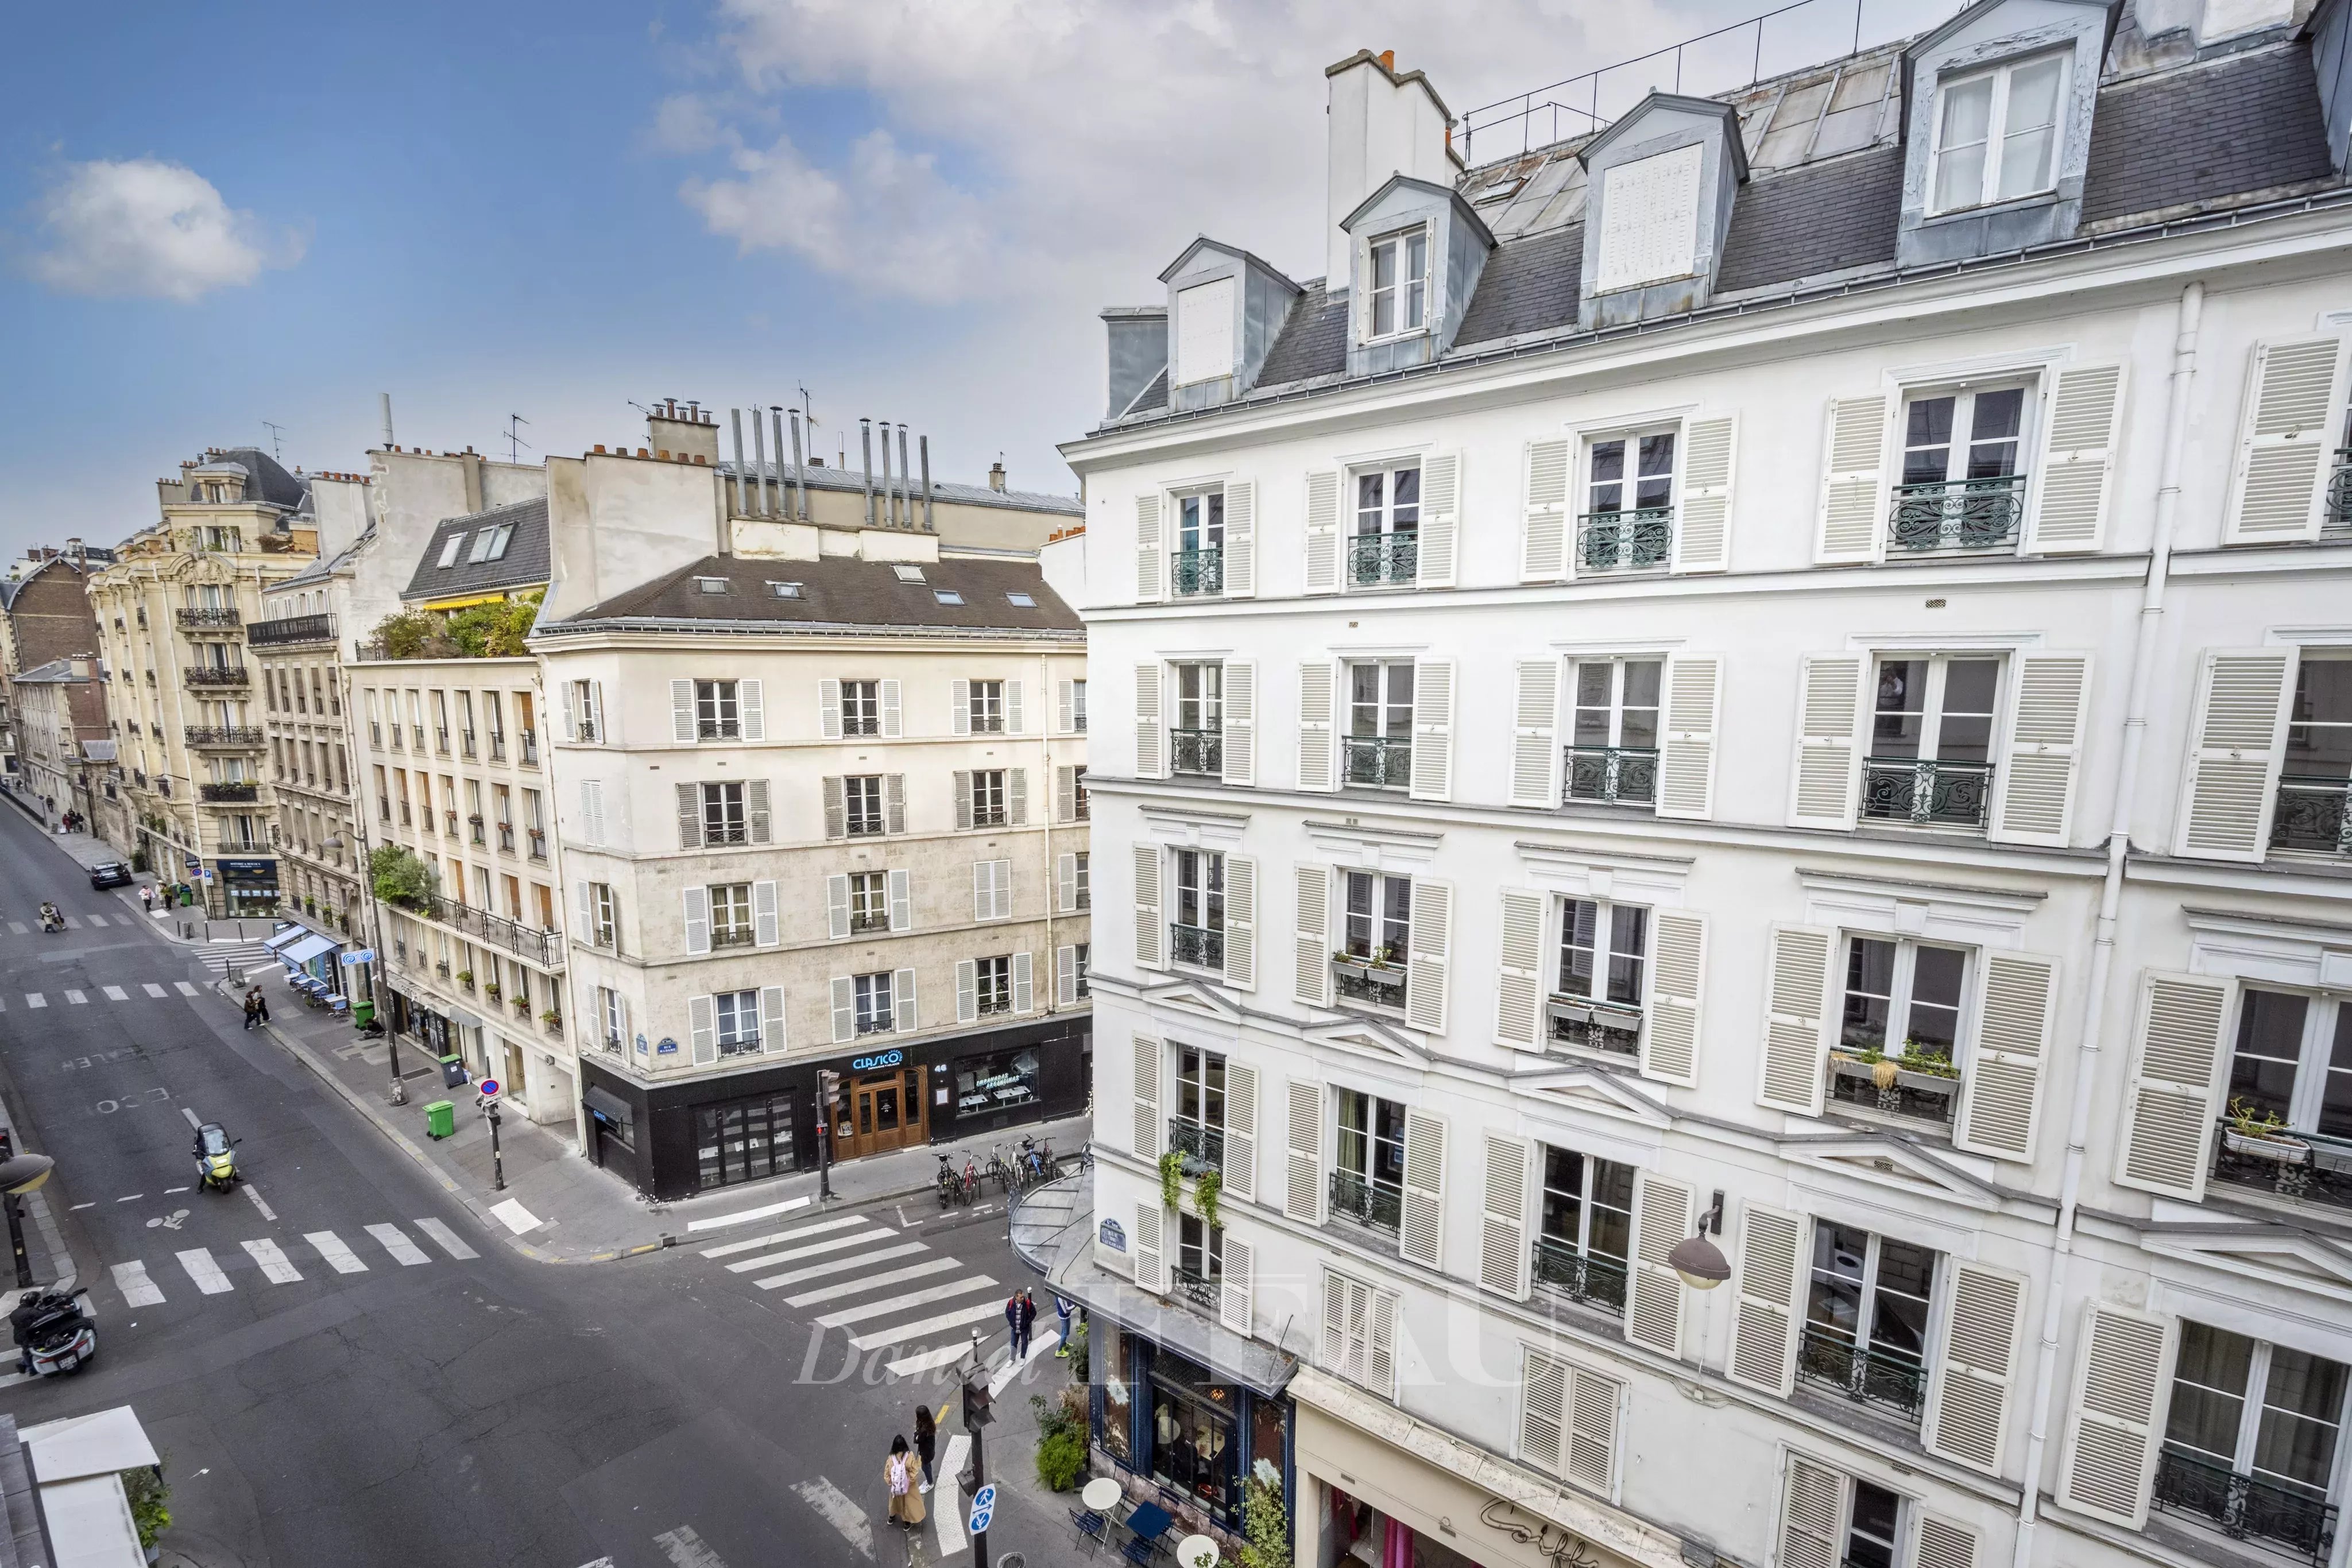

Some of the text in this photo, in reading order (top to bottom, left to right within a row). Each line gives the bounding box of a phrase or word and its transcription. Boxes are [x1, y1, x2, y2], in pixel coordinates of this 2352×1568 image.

[853, 1053, 899, 1070] CLASICO
[888, 1050, 903, 1062] ARGENTINO
[934, 1064, 947, 1073] 46
[976, 1073, 1009, 1087] EMPANADAS
